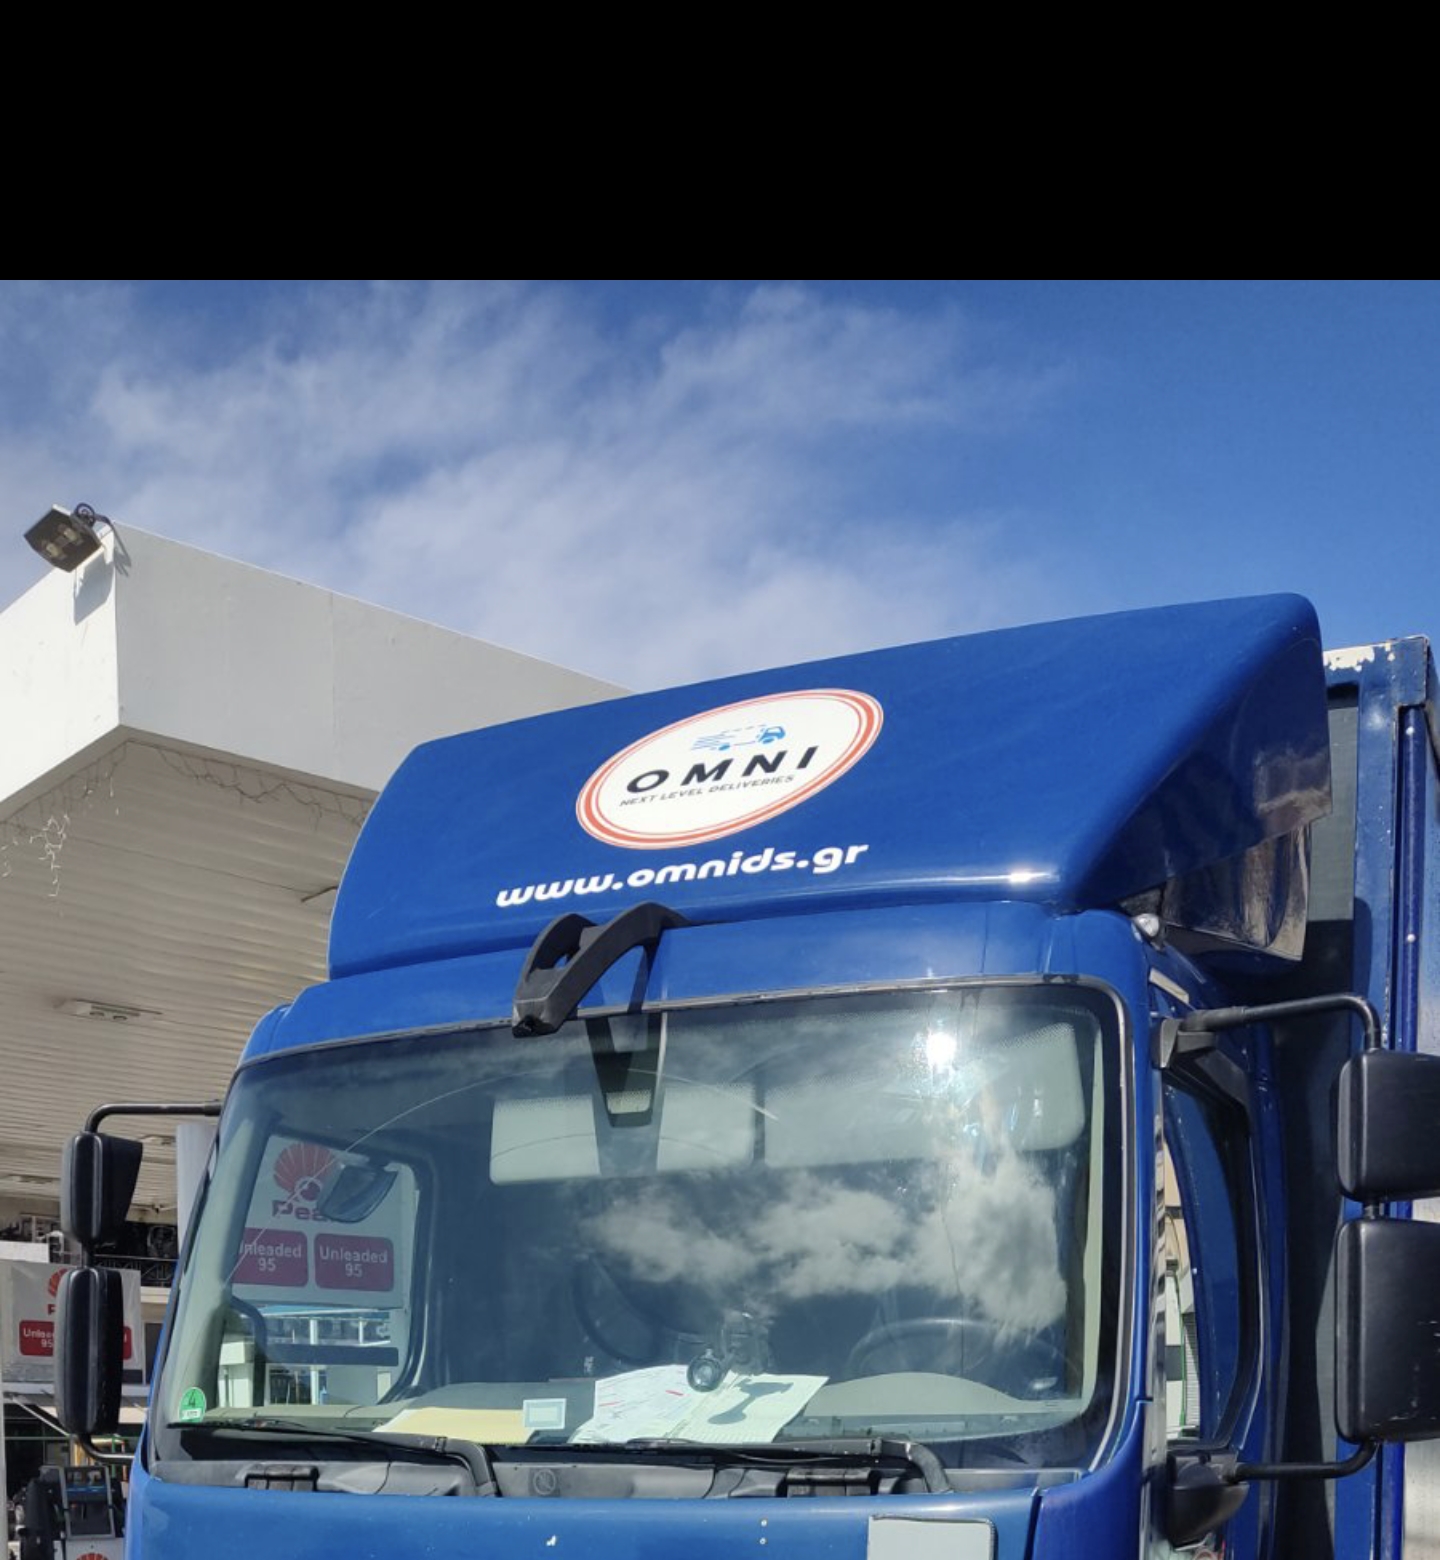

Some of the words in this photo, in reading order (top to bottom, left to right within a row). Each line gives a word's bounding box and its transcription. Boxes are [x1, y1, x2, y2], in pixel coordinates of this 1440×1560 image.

[626, 745, 819, 793] OMNI
[619, 794, 658, 807] NEXT
[660, 788, 704, 801] LEVEL
[707, 774, 795, 793] DELIVERIES
[495, 843, 870, 908] www.omnids.gr
[258, 1256, 277, 1273] 95
[319, 1245, 388, 1264] Unleaded
[344, 1263, 363, 1278] 95
